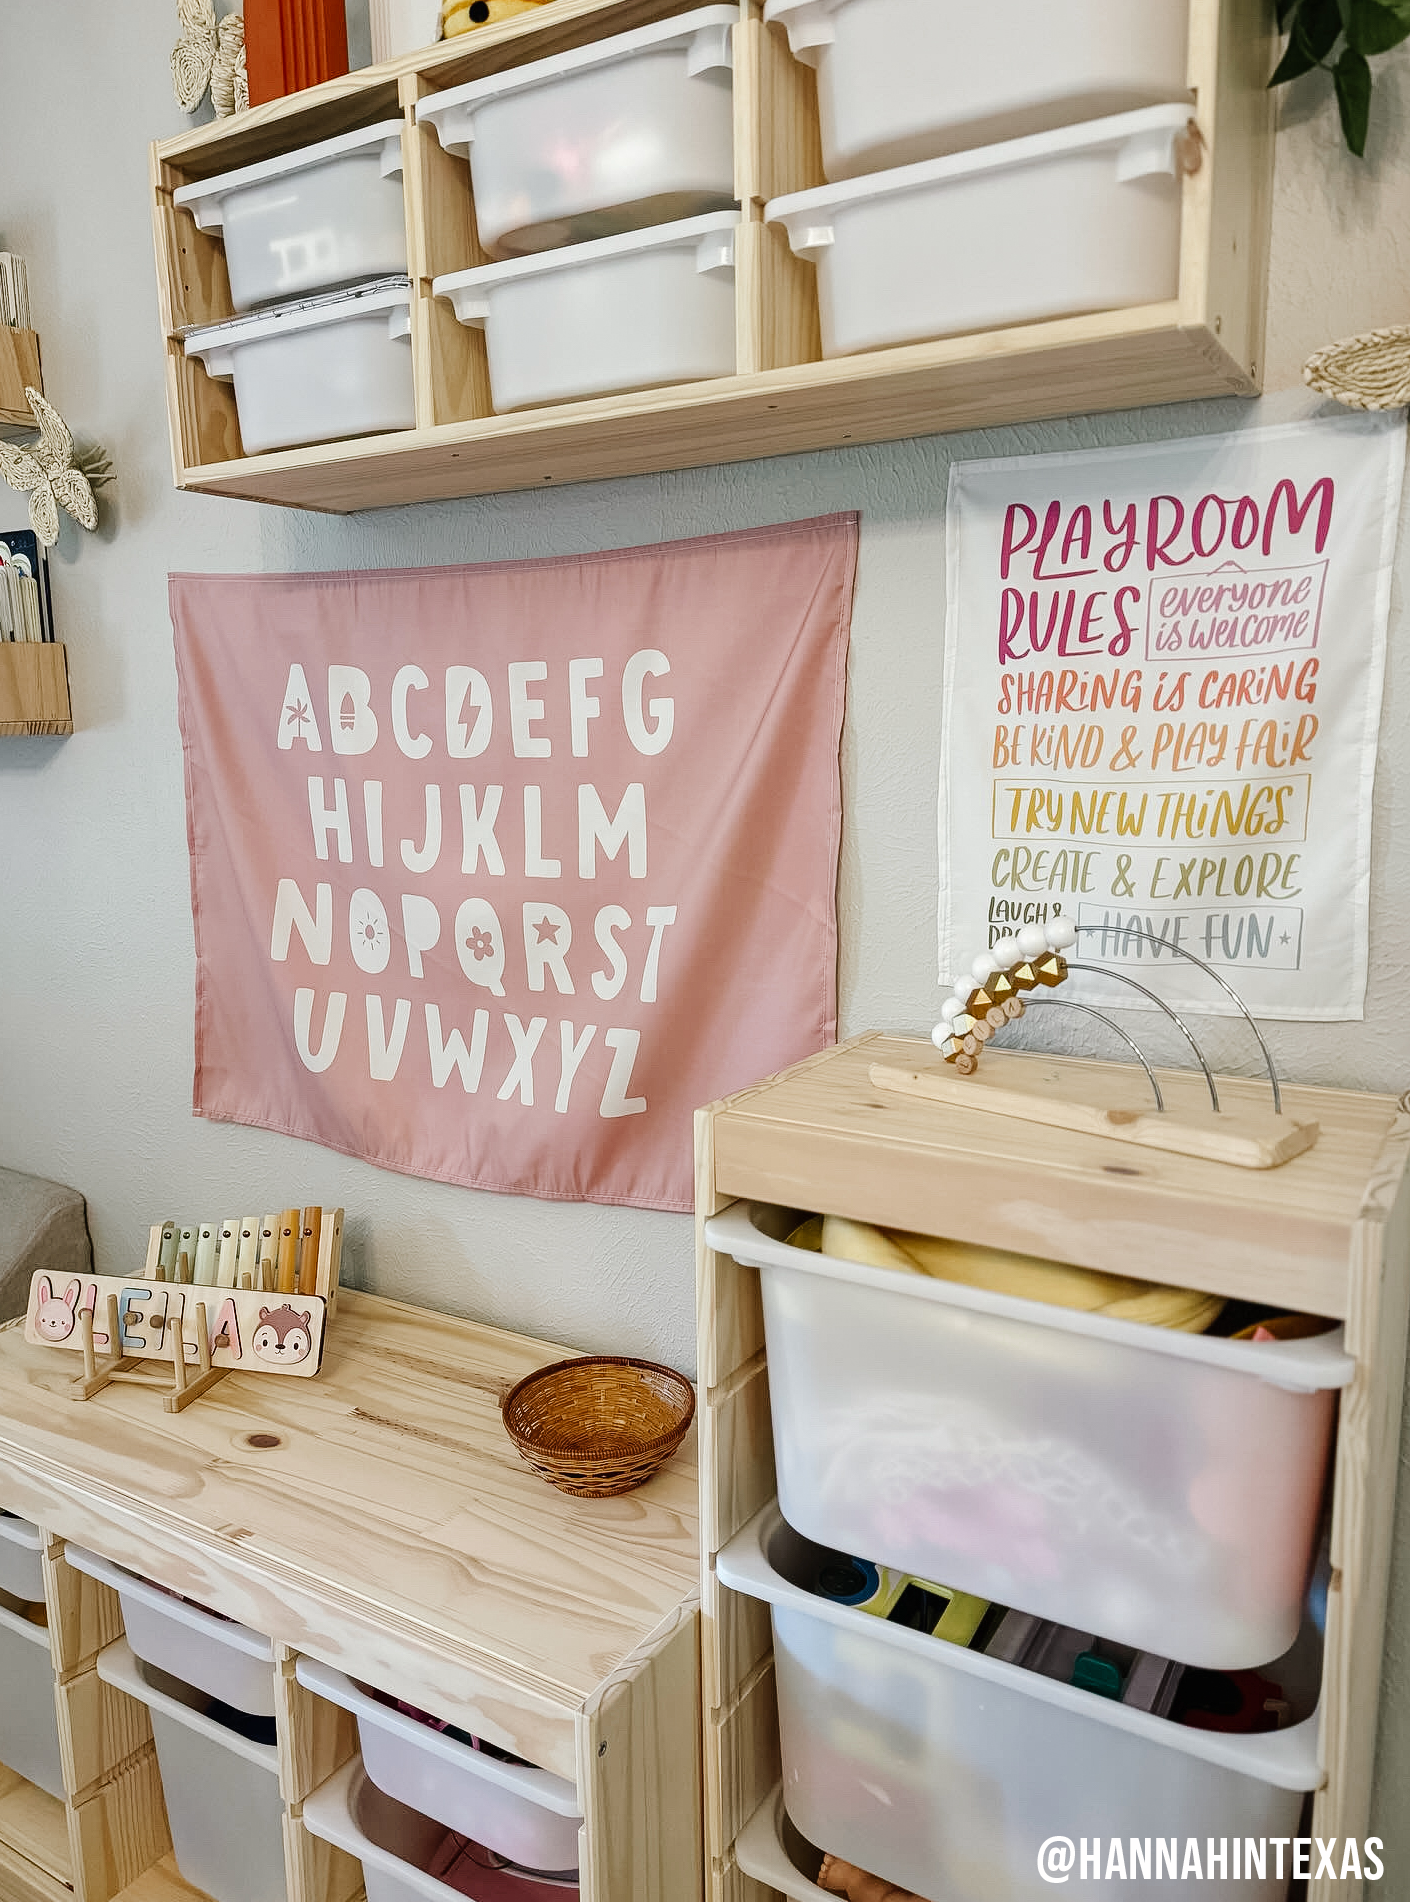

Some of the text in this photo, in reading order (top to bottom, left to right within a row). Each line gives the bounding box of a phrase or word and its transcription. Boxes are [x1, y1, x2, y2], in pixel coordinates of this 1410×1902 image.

[1000, 477, 1334, 580] PLAYROOM
[1160, 576, 1311, 618] everyone
[999, 586, 1140, 665] RULES
[1154, 624, 1184, 651] is
[277, 649, 675, 759] ABCDEFG
[1110, 723, 1142, 772] &
[1151, 721, 1229, 772] PLAY
[307, 776, 647, 879] HIJKLM
[1004, 787, 1069, 834] TRY
[1070, 789, 1149, 837] NEW
[991, 845, 1303, 900] CREATE & EXPLORE
[988, 896, 1048, 924] LAUGH
[1100, 911, 1195, 958] HAVE
[1199, 912, 1275, 959] FUN
[270, 878, 677, 1003] NOPQRST
[293, 987, 647, 1119] UVWXYZ
